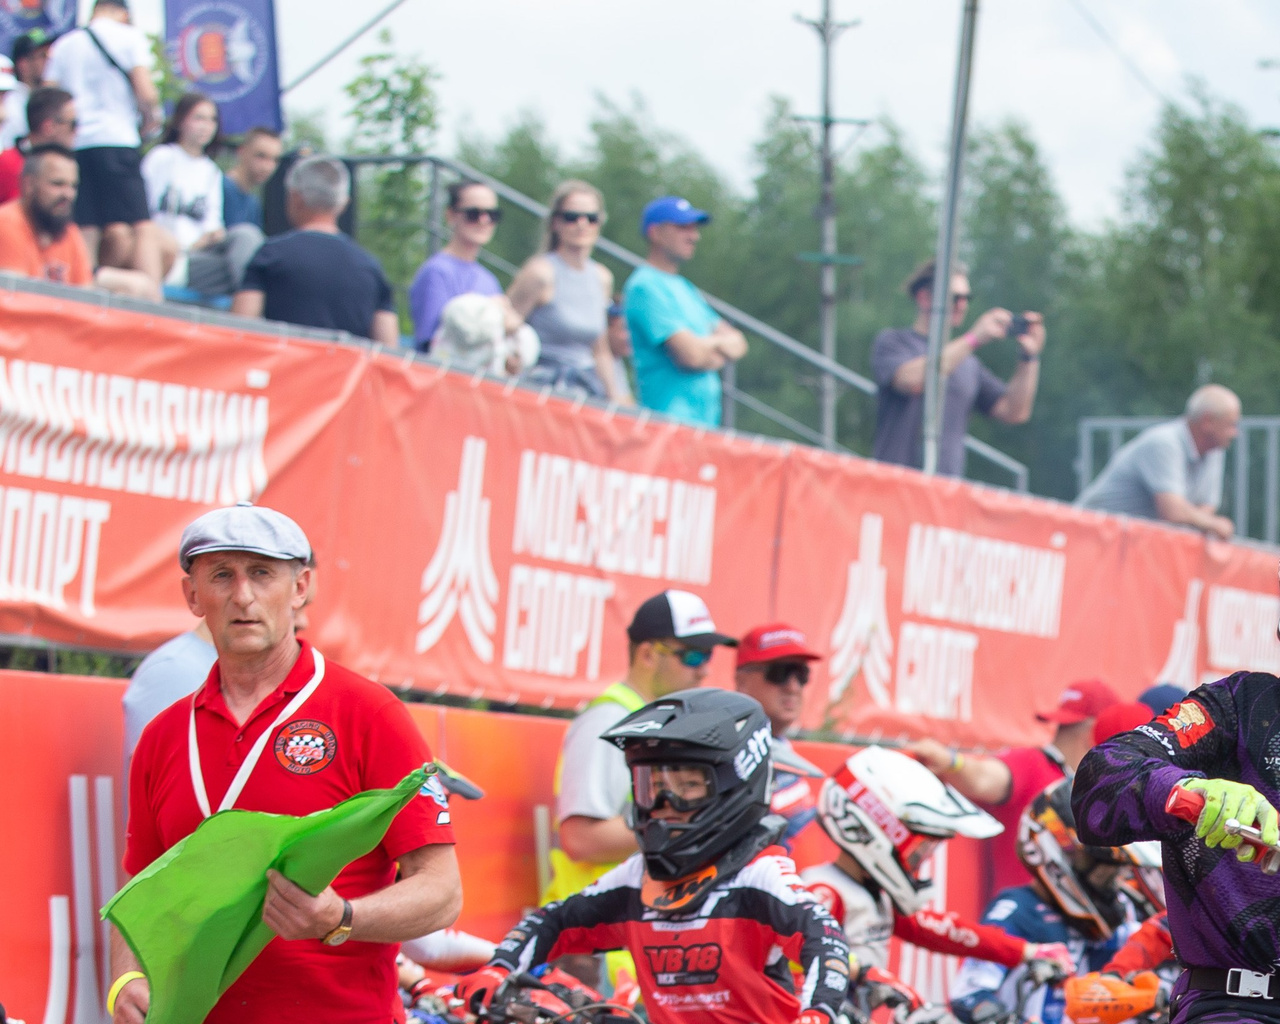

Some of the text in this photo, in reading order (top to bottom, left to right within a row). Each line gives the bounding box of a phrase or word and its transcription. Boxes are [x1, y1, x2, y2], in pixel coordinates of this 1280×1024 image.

[0, 486, 111, 617] ПОРТ
[503, 563, 616, 682] СПОРТ
[896, 622, 979, 722] СПОРТ
